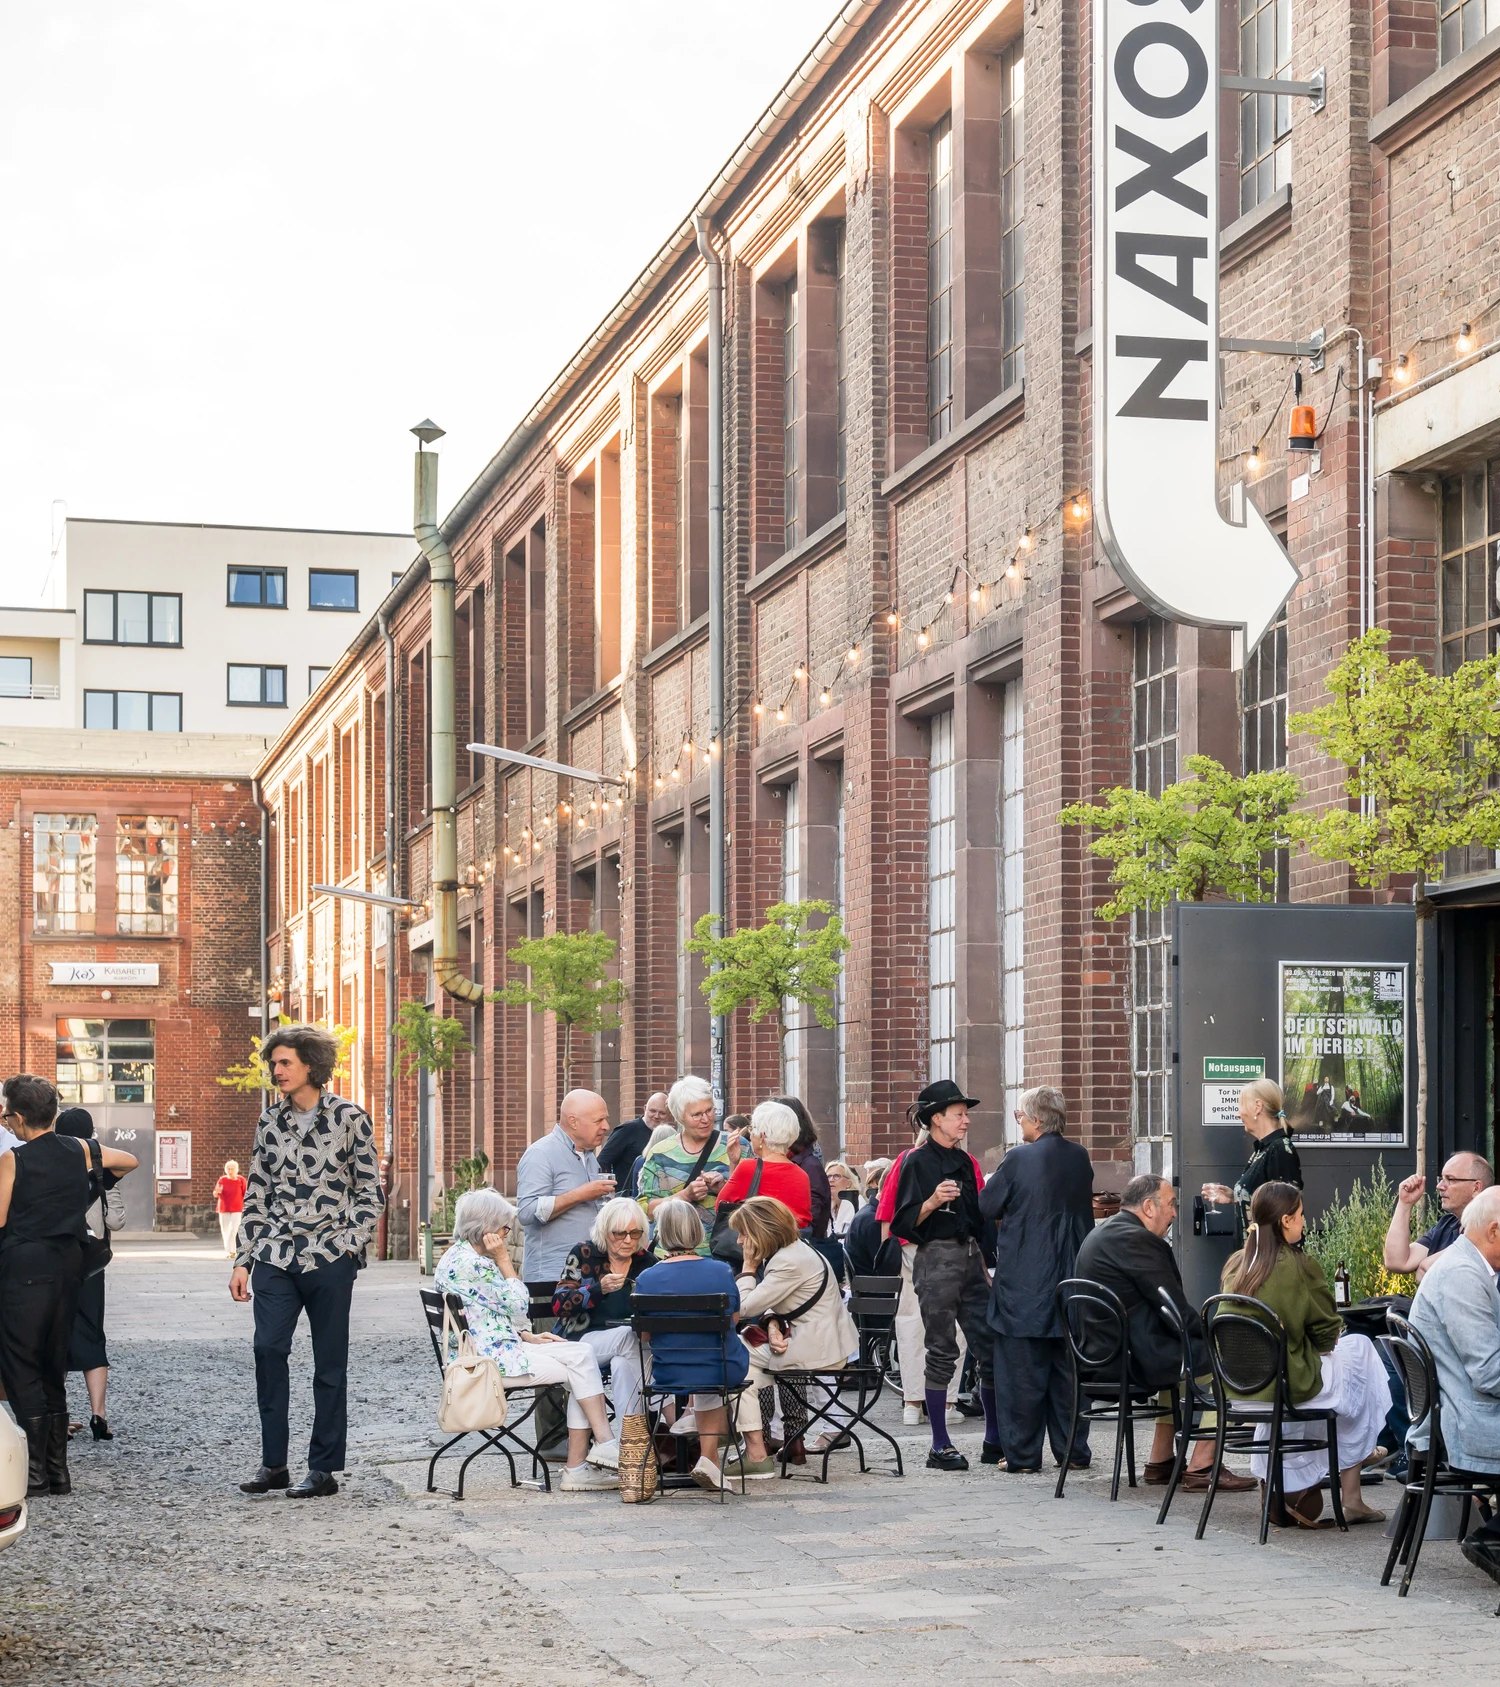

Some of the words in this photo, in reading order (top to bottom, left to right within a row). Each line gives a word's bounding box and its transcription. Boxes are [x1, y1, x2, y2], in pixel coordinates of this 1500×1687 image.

[1114, 0, 1209, 422] NAXO
[1285, 1018, 1402, 1035] DEUTSCHWALD
[1285, 1037, 1305, 1054] IM
[1313, 1037, 1374, 1054] HERBST
[1208, 1062, 1261, 1074] Notausgang
